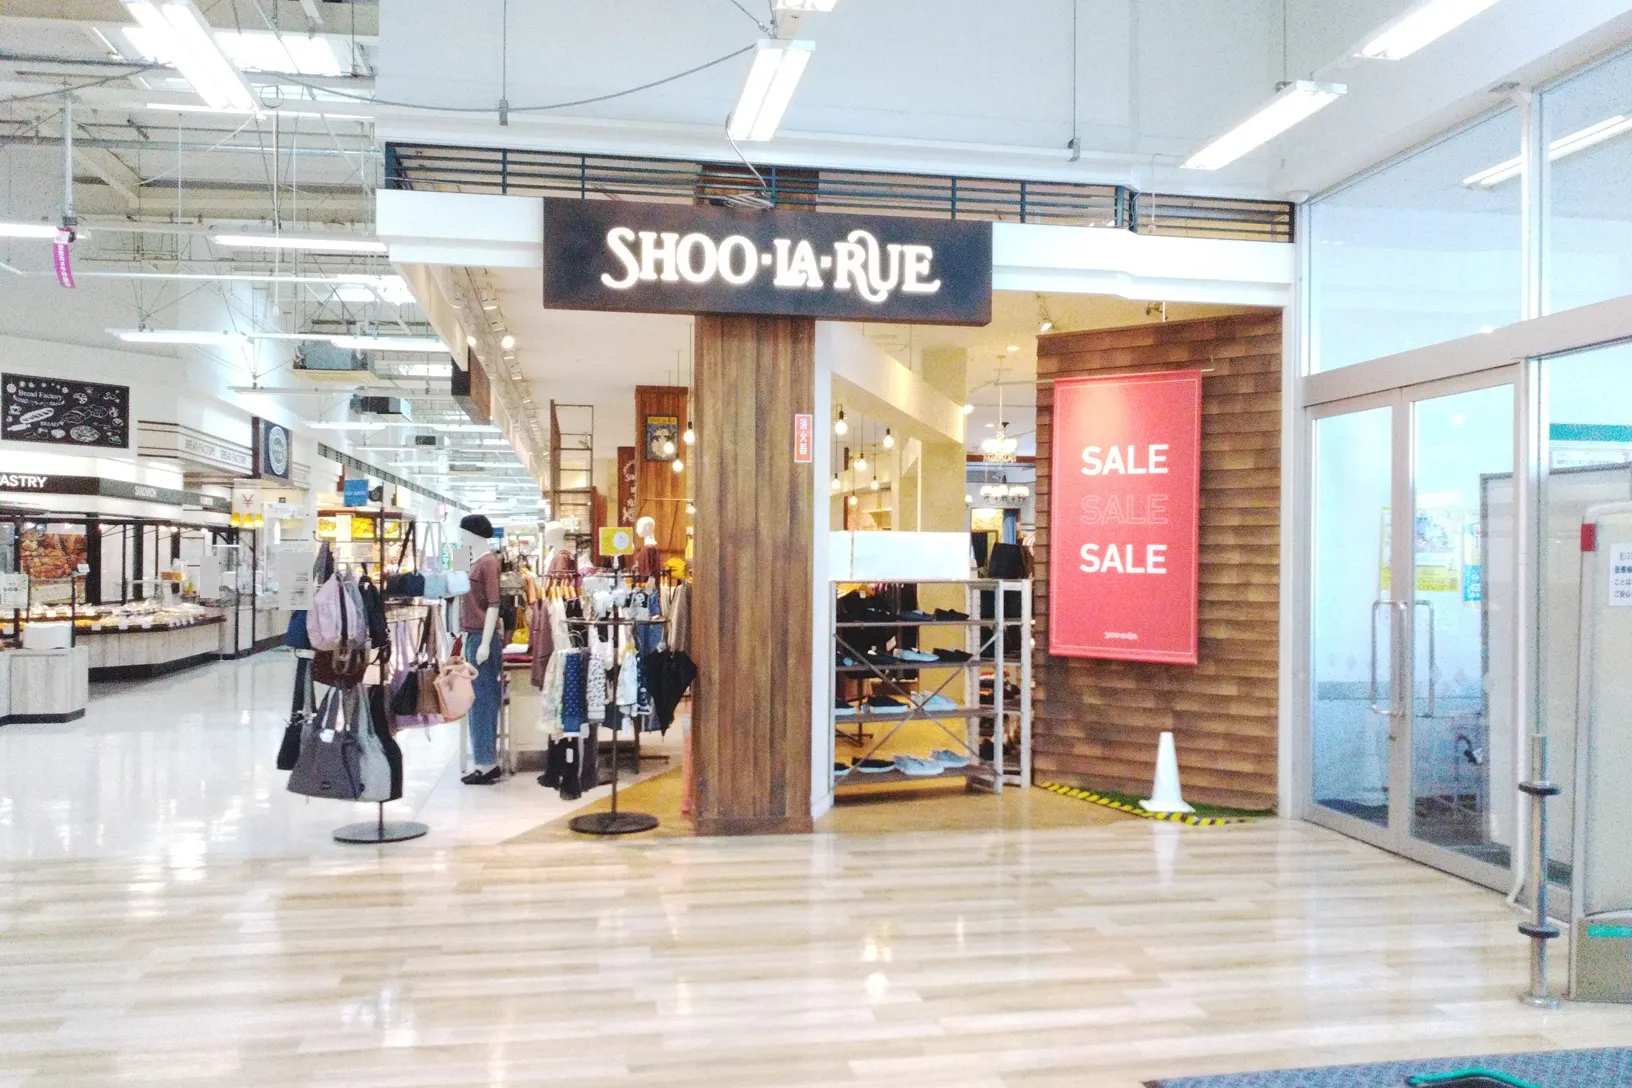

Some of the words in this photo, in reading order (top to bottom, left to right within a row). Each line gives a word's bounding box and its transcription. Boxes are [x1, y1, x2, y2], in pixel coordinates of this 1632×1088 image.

[799, 418, 808, 455] 消火器
[1081, 444, 1168, 476] SALE
[0, 474, 48, 488] ASTRY
[1080, 494, 1168, 525] SALE
[1079, 543, 1167, 574] SALE
